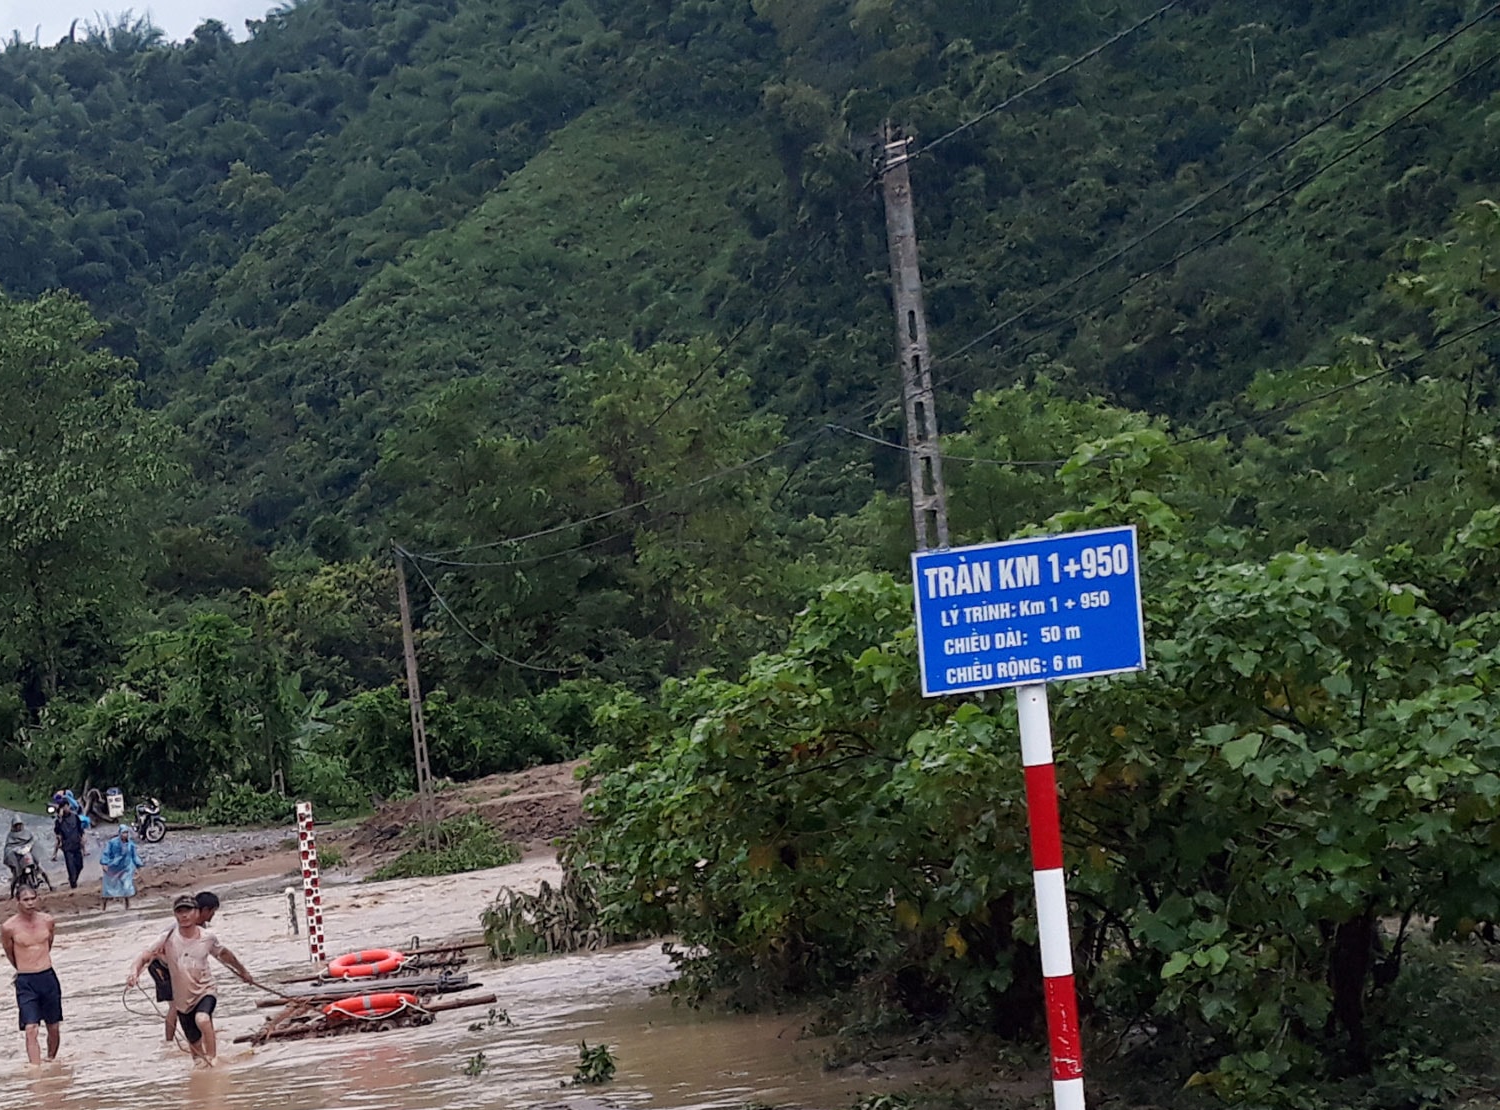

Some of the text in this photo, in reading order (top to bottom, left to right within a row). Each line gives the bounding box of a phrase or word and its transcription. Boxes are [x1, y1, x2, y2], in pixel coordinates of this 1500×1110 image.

[924, 543, 1129, 599] TRÀN KM 1+950
[941, 604, 959, 627] LÝ
[1020, 599, 1046, 617] Km
[1050, 597, 1058, 612] 1
[1064, 598, 1076, 609] +
[1080, 590, 1110, 609] 950
[944, 625, 1081, 655] CHIỀU DÀI: 50 m
[946, 655, 1082, 684] CHIỀU RỘNG: 6 m
